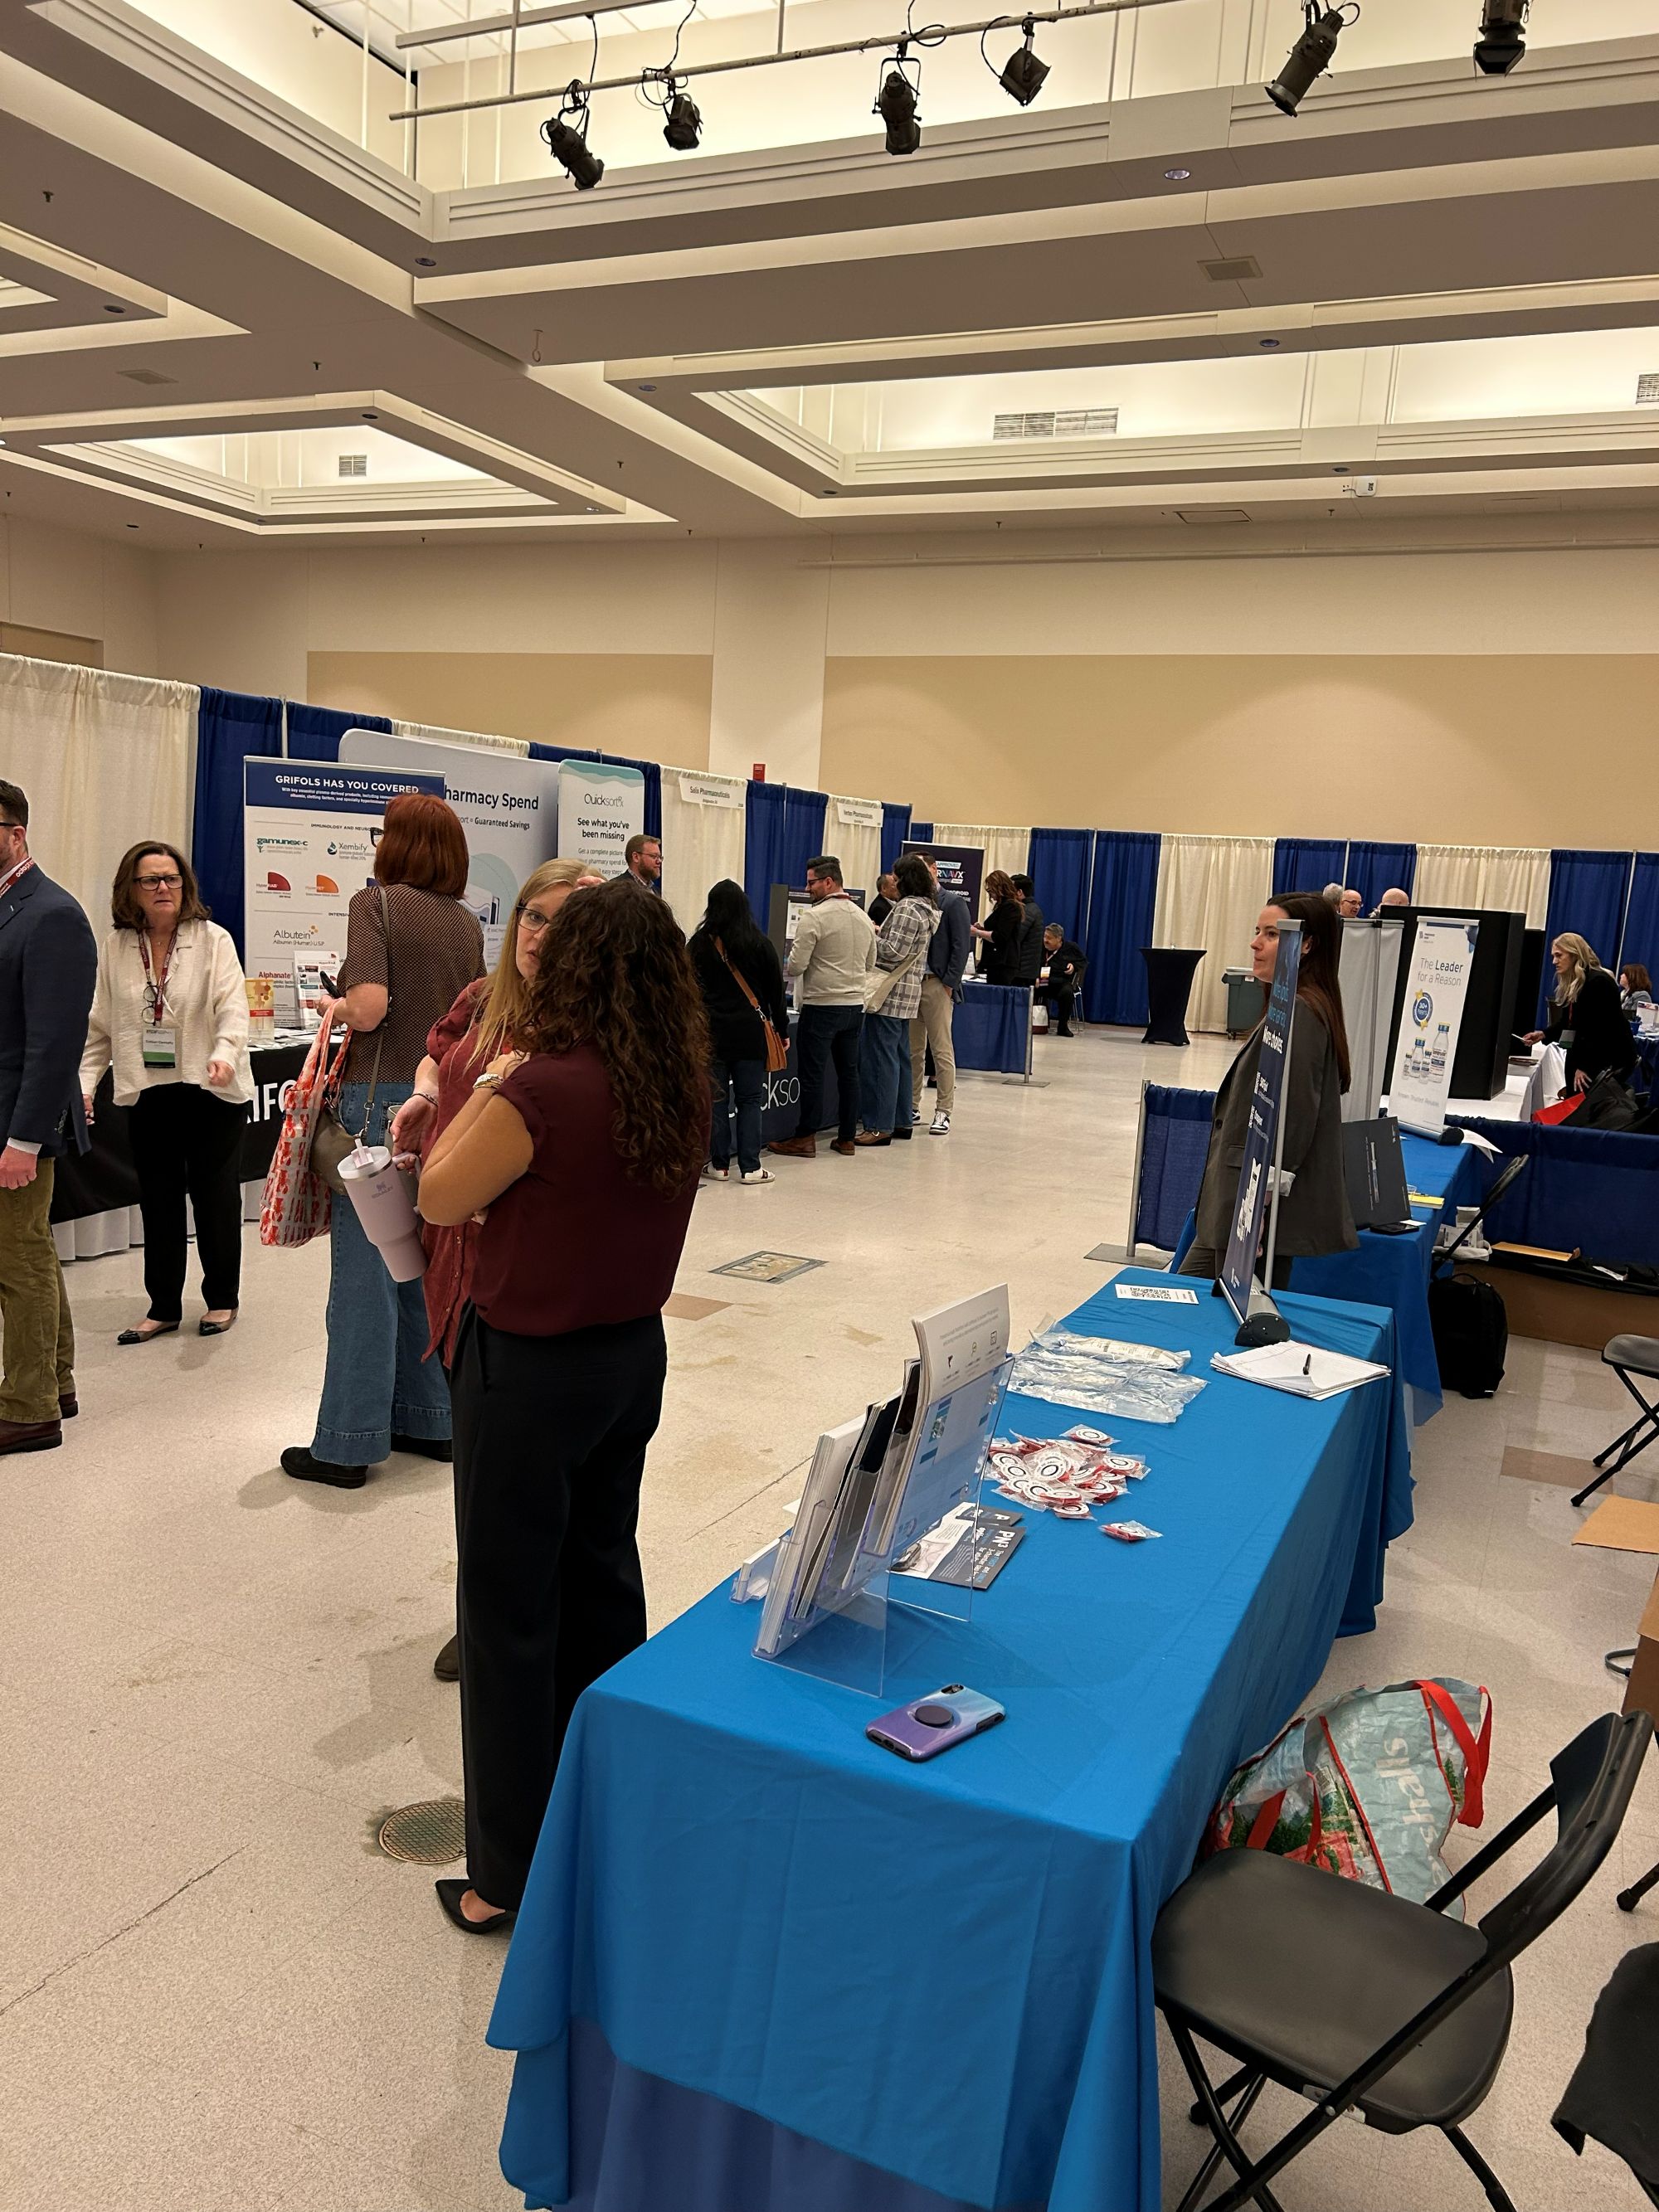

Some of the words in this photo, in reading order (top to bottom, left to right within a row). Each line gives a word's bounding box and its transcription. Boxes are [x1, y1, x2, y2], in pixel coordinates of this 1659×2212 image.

[275, 775, 321, 786] GRIFOLS
[323, 779, 344, 788] HAS
[347, 780, 368, 790] YOU
[371, 783, 419, 794] COVERED
[445, 785, 499, 809] harmacy
[502, 793, 538, 810] Spend
[700, 788, 730, 799] Pharmaceuticals
[474, 817, 508, 828] Guaranteed
[509, 820, 530, 830] Savings
[577, 817, 590, 826] See
[591, 819, 608, 827] what
[609, 820, 630, 829] you've
[581, 829, 599, 838] been
[600, 830, 625, 842] missing
[338, 842, 367, 853] Xembify
[590, 848, 608, 857] complete
[937, 869, 964, 879] RNAVX
[273, 930, 311, 939] Albutein
[1420, 957, 1434, 969] The
[1435, 960, 1463, 973] Leader
[258, 971, 291, 980] Alphanate
[1418, 971, 1428, 982] for
[1435, 974, 1462, 986] Reason
[1375, 1738, 1446, 1887] rshalls
